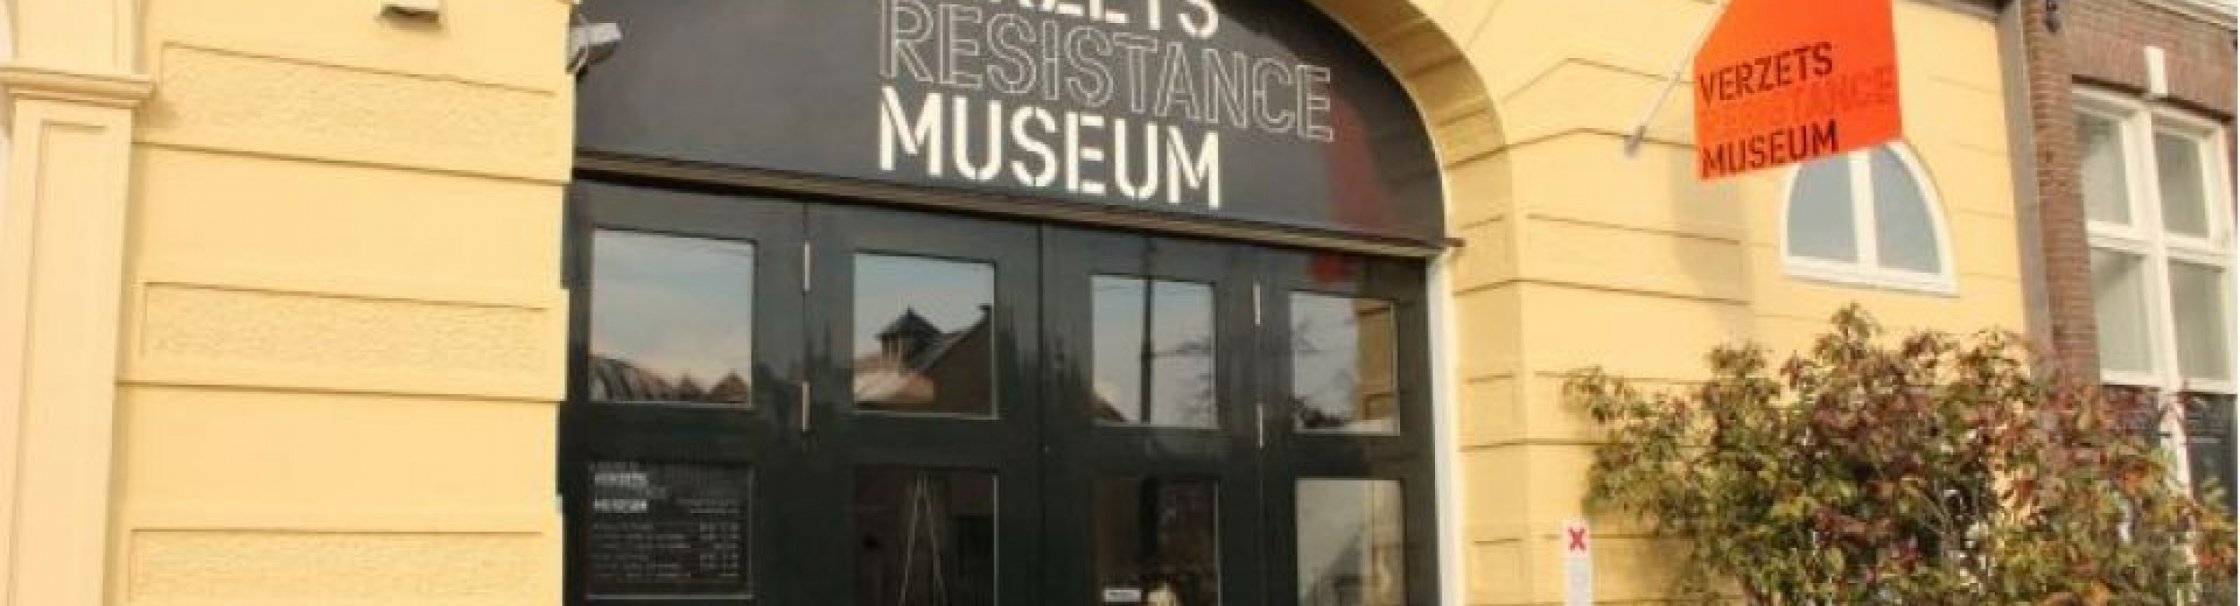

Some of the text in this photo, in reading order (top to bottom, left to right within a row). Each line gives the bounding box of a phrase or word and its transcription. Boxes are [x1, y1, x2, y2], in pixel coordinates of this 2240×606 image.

[879, 0, 1334, 142] RESISTANCE
[1700, 41, 1833, 107] VERZETS
[878, 85, 1222, 209] MUSEUM
[1702, 118, 1839, 180] MUSEUM
